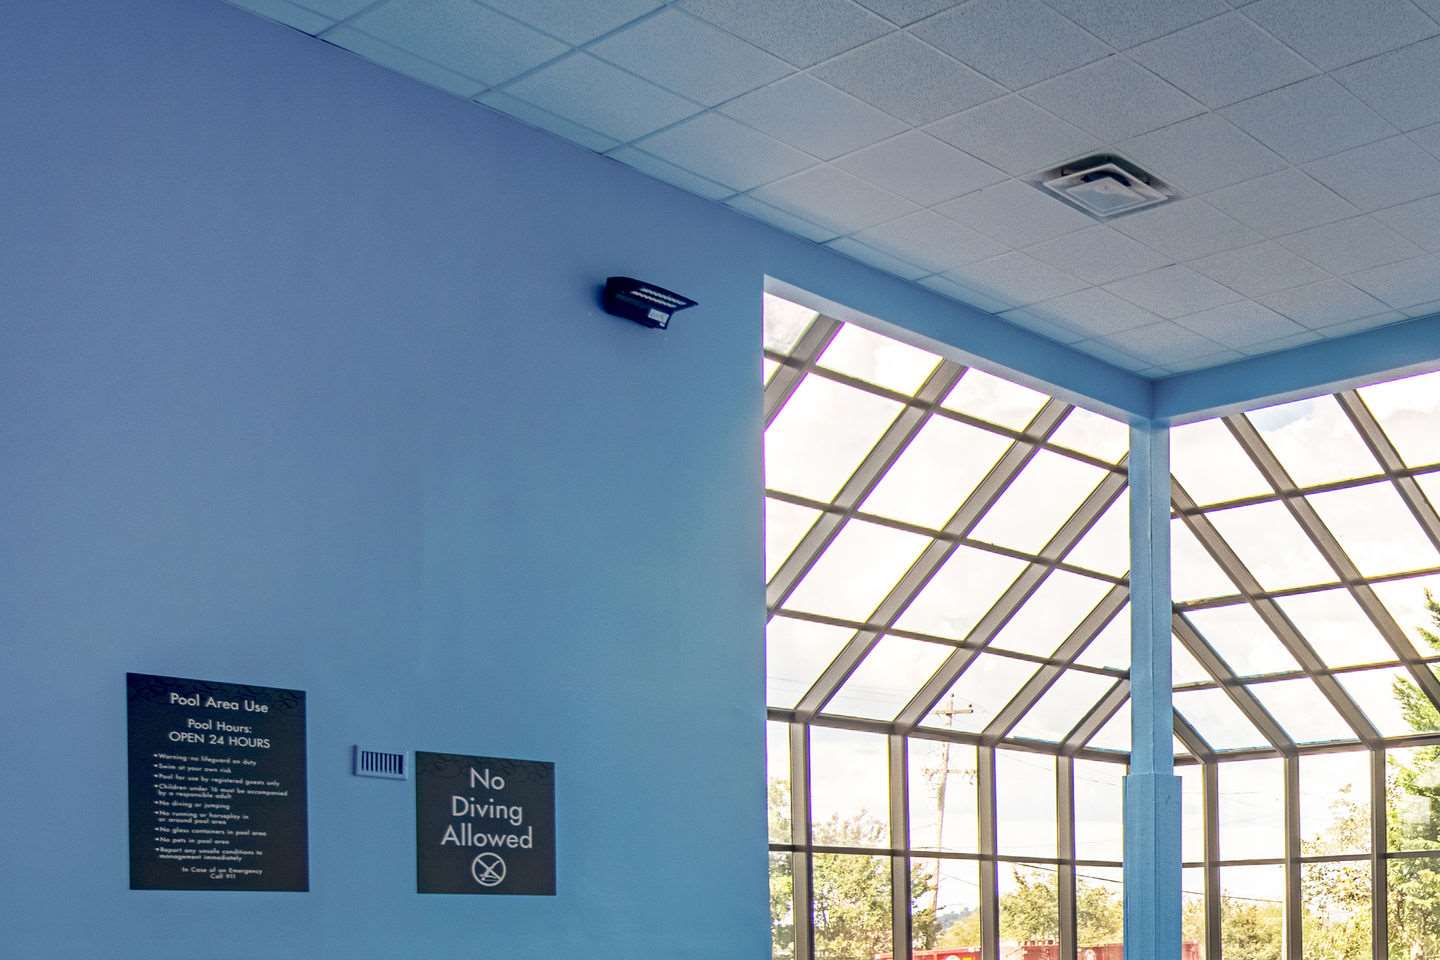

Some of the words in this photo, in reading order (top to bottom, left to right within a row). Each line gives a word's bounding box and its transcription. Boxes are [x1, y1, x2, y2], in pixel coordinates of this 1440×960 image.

[170, 692, 200, 706] Pool
[206, 697, 239, 710] Area
[244, 700, 268, 713] Use
[187, 719, 212, 730] Pool
[216, 721, 252, 734] Hours:
[168, 731, 205, 744] OPEN
[209, 734, 225, 745] 24
[229, 736, 271, 749] HOURS
[470, 767, 505, 790] No
[452, 795, 523, 826] Diving
[440, 822, 533, 849] Allowed
